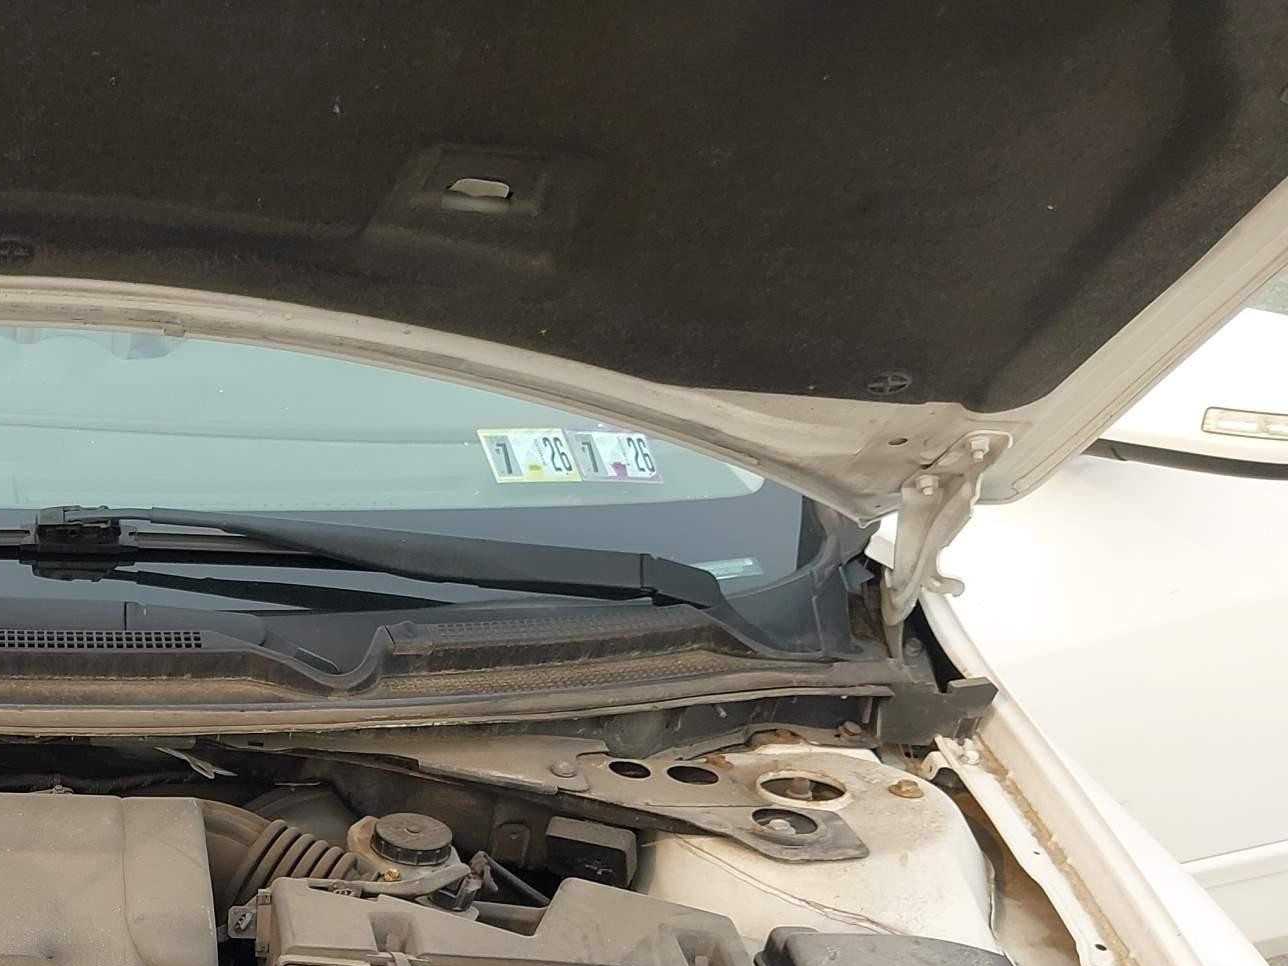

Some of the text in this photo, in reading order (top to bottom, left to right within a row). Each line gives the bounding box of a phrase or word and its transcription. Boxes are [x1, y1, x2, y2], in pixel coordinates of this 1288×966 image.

[496, 442, 513, 475] 7
[542, 436, 573, 472] 26
[581, 441, 599, 473] 7
[627, 437, 656, 473] 26
